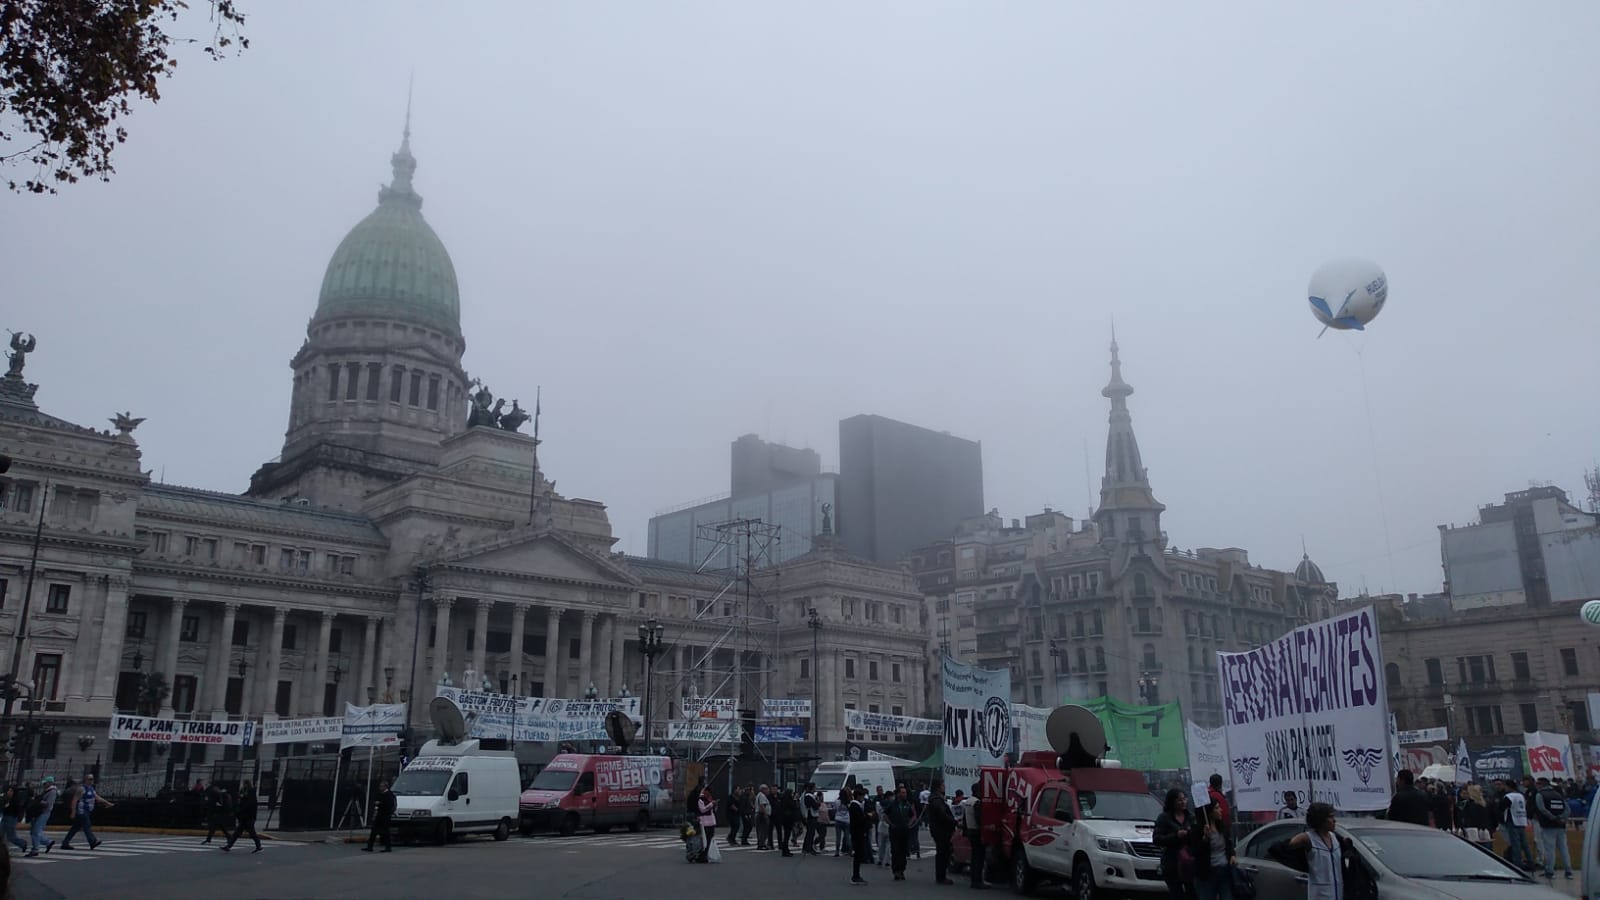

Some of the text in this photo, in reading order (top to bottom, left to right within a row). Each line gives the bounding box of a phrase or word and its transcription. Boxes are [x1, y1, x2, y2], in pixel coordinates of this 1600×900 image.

[1220, 611, 1377, 726] AERONAVEGANTES
[459, 695, 488, 705] GASTON
[181, 721, 239, 736] TRABAJO
[130, 732, 222, 743] MARCELO MONTERO
[595, 759, 622, 773] FIRME
[596, 766, 662, 793] PUEBLO
[1273, 788, 1342, 809] CODUCCIÓN
